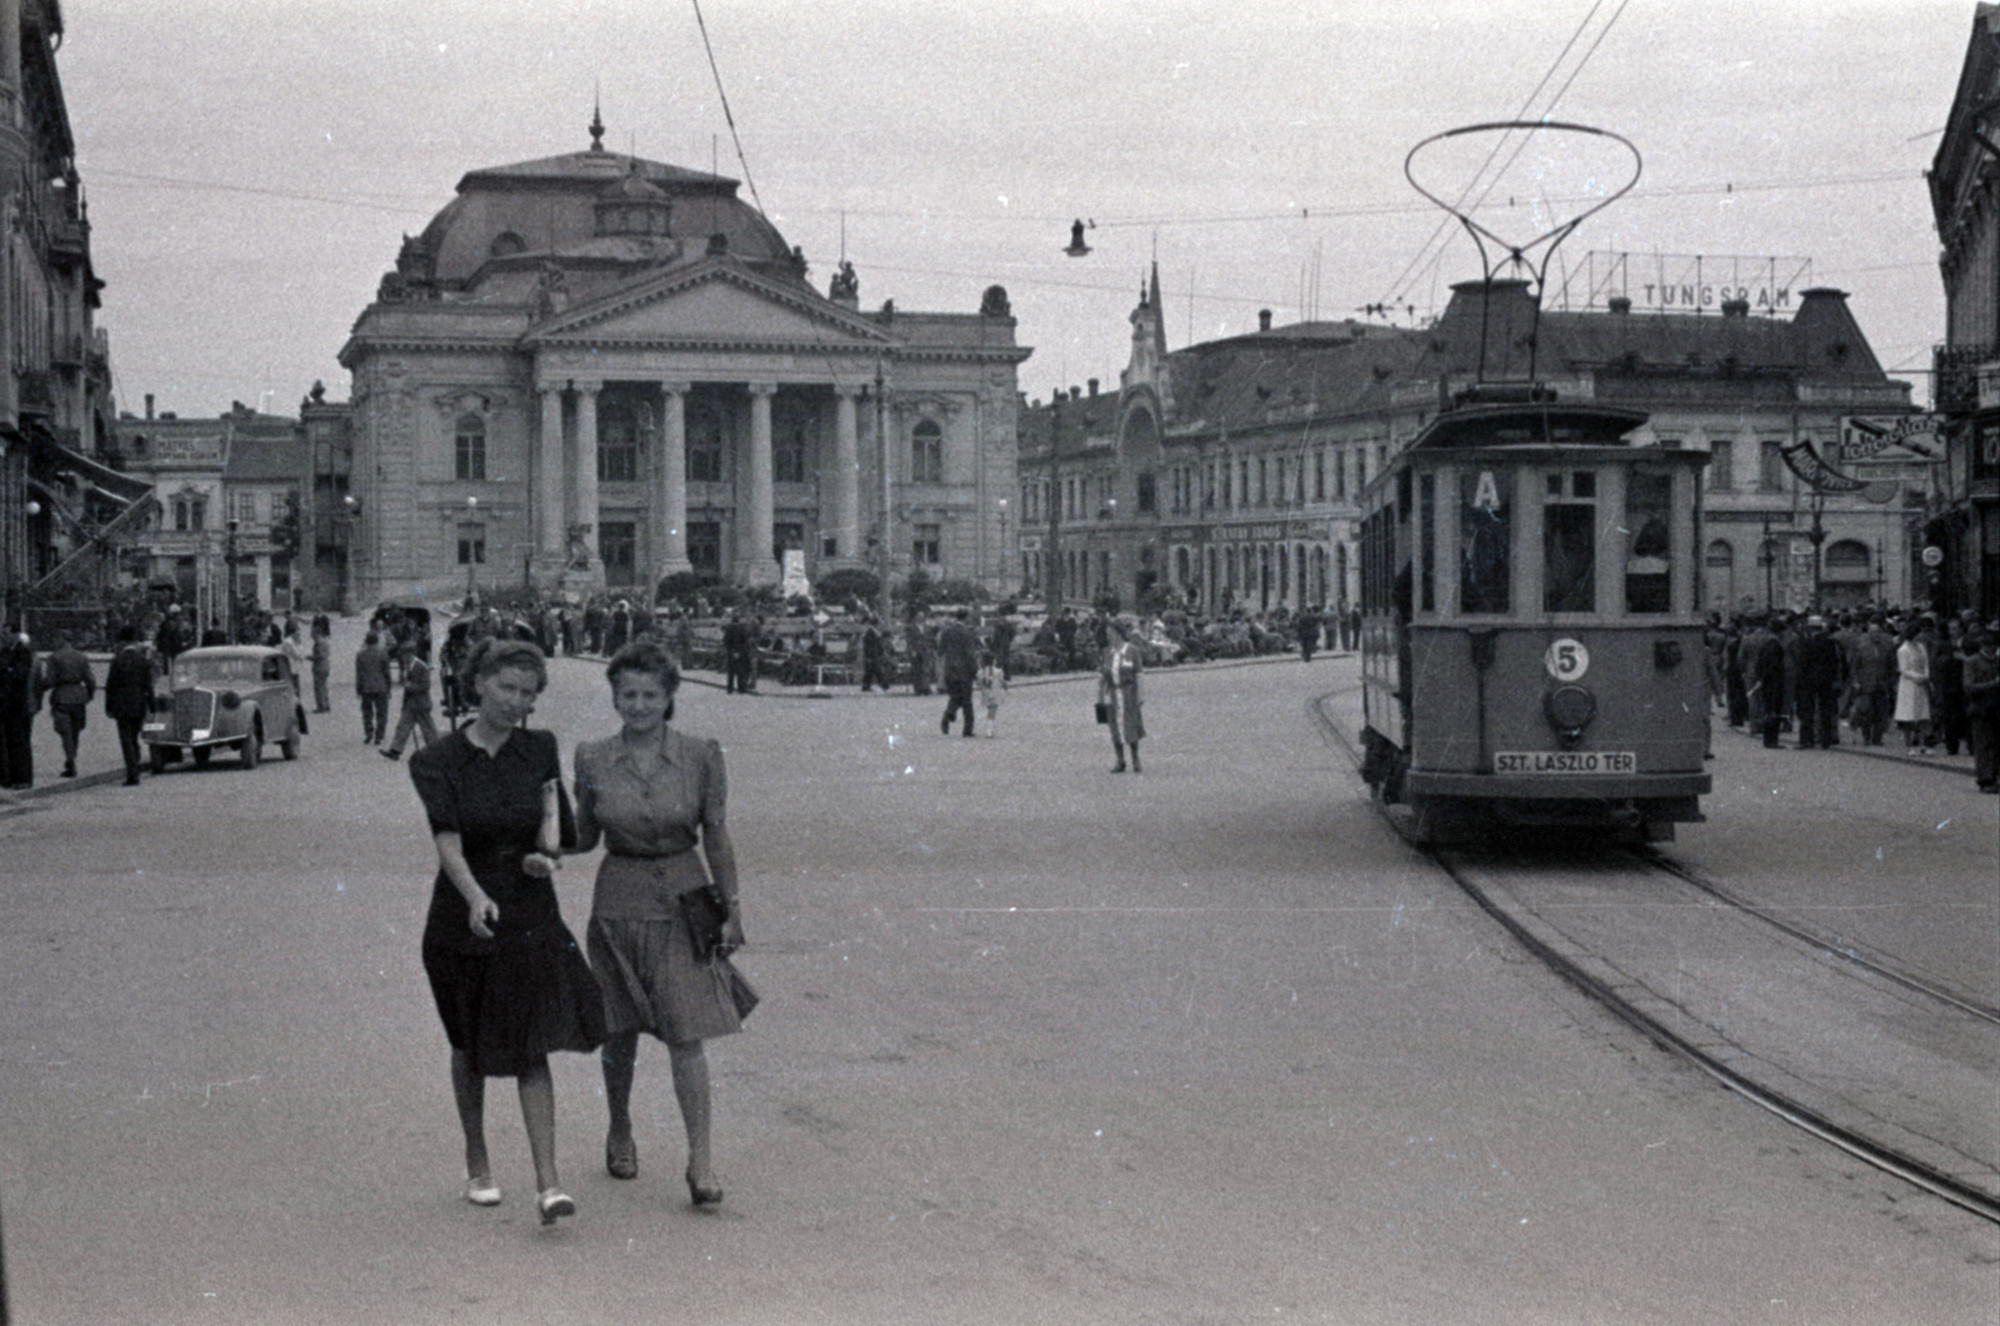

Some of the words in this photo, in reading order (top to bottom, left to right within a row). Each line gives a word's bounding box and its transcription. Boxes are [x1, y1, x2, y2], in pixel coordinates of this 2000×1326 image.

[1644, 284, 1790, 308] TUNGSRAM
[1473, 471, 1500, 507] A
[1558, 645, 1577, 673] 5
[1498, 754, 1531, 770] SZT.
